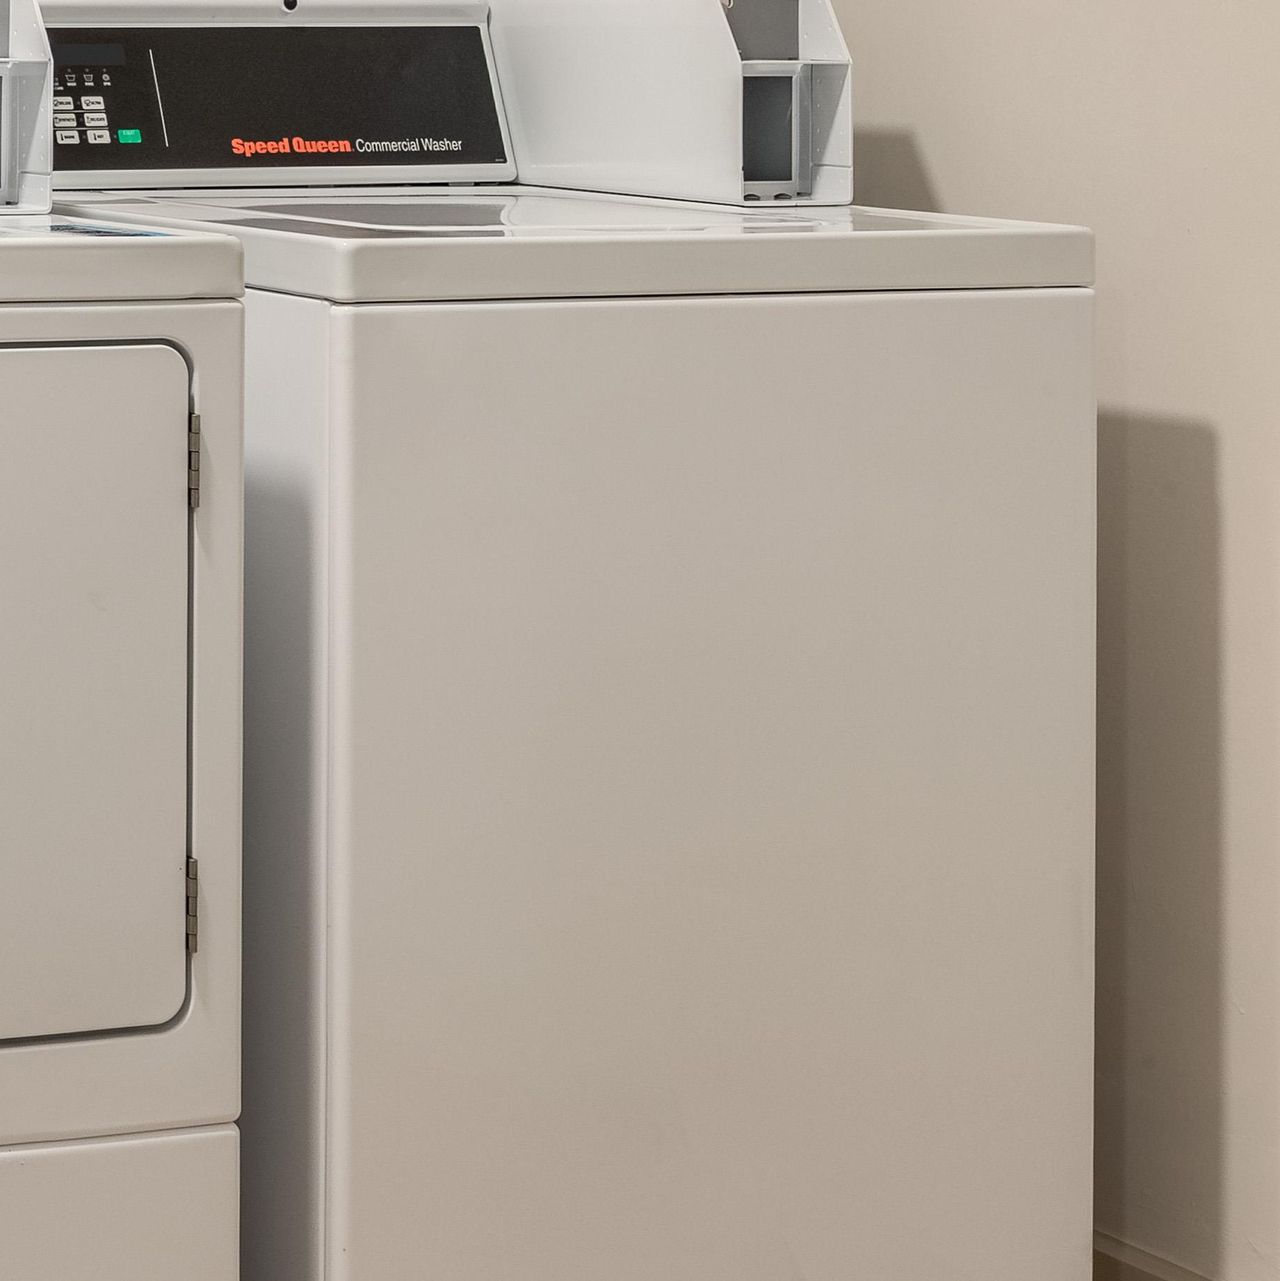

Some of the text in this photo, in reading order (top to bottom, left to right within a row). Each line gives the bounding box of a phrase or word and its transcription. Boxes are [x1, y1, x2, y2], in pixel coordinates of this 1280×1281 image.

[231, 136, 462, 157] Speed Queen Commercial Washer
